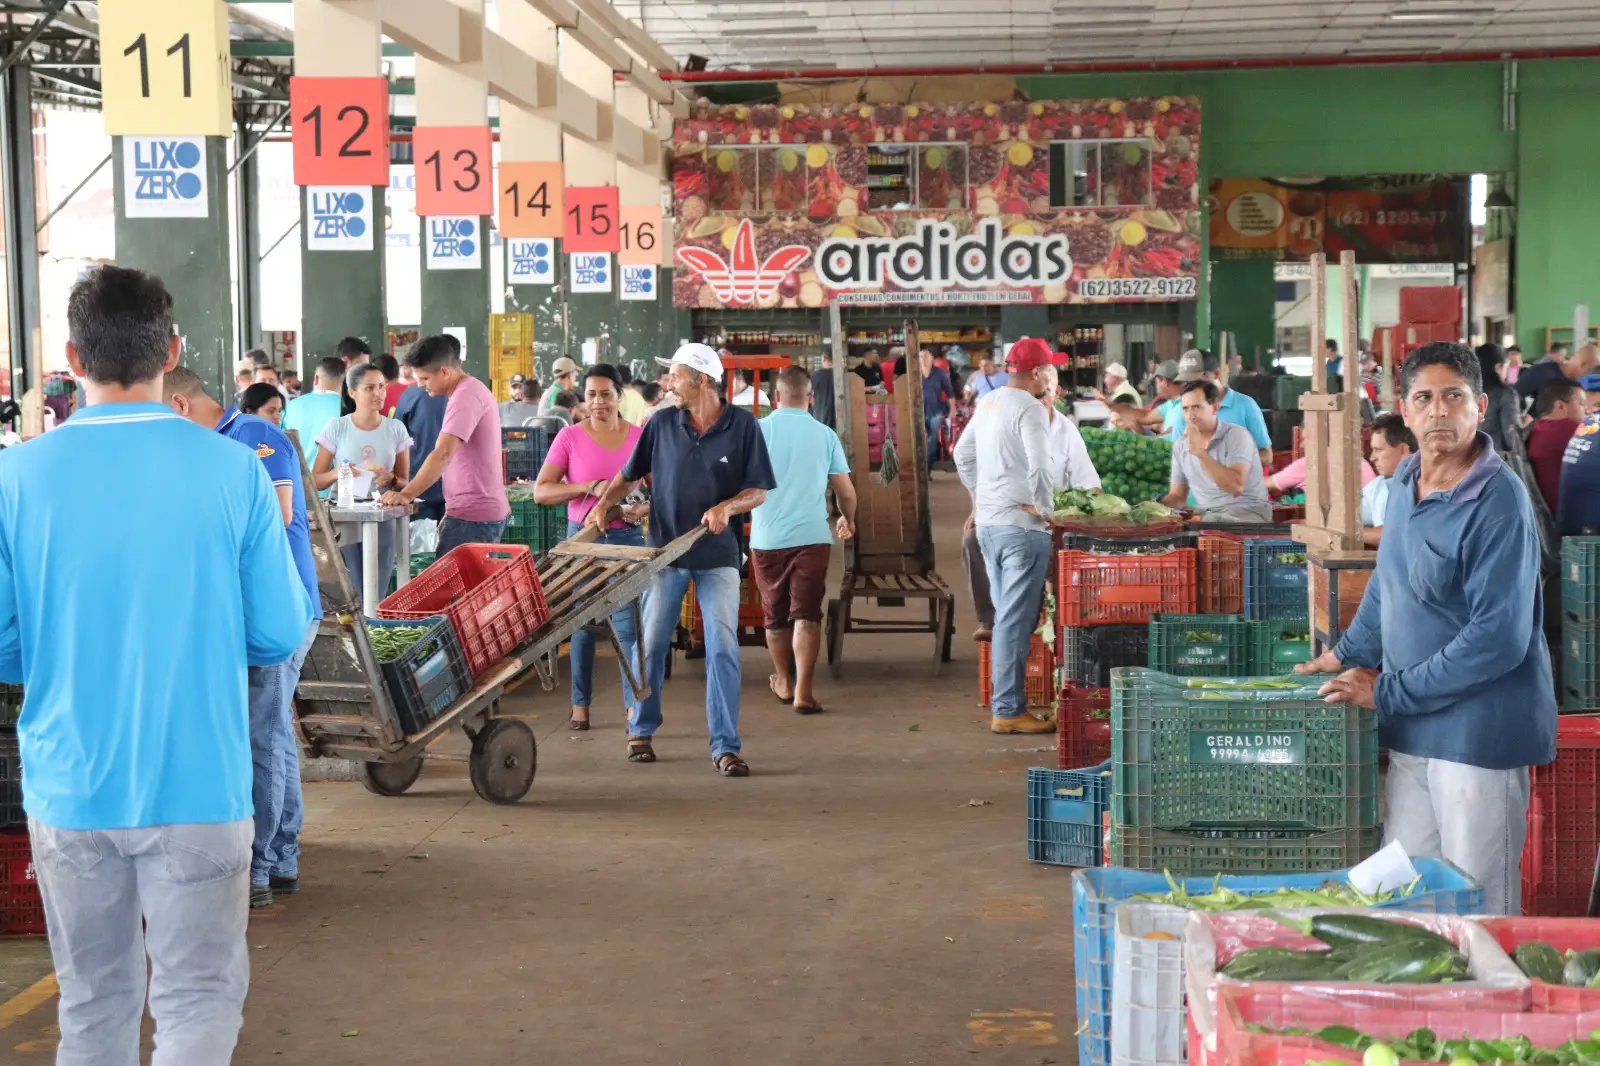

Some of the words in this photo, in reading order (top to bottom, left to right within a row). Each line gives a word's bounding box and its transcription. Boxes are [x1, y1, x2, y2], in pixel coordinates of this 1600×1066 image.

[124, 33, 191, 98] 11
[302, 105, 372, 157] 12
[134, 141, 200, 169] LIXO
[424, 149, 481, 192] 13
[135, 170, 202, 200] ZERO
[505, 181, 551, 217] 14
[313, 192, 364, 215] LIXO
[314, 215, 366, 239] ZERO
[432, 219, 475, 238] LIXO
[568, 204, 611, 236] 15
[432, 239, 475, 257] ZERO
[512, 242, 548, 258] LIXO
[619, 222, 655, 250] 16
[512, 259, 549, 275] ZERO
[820, 224, 1066, 282] ardidas
[1081, 279, 1195, 297] (62)3522-9122
